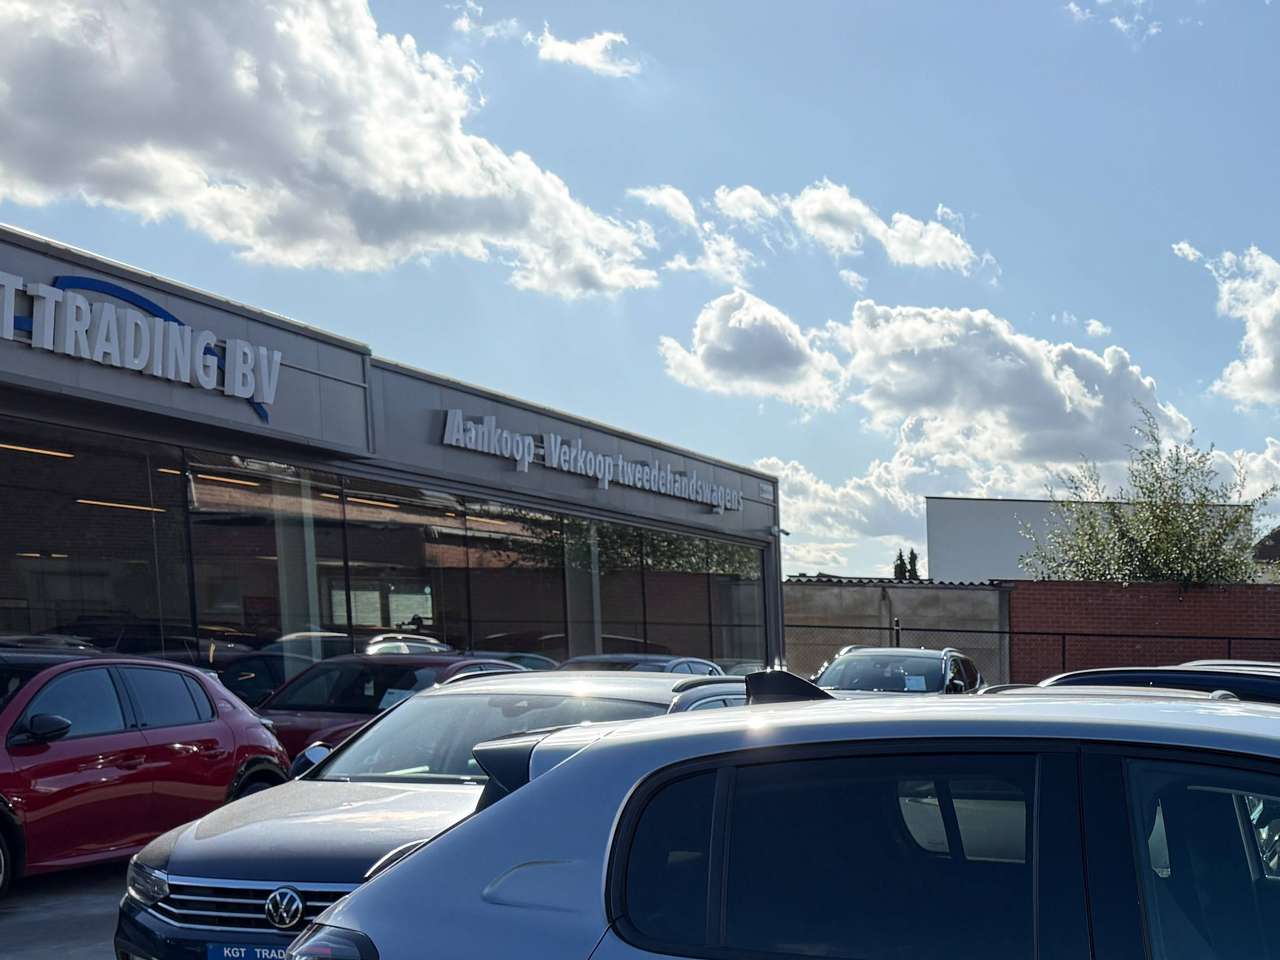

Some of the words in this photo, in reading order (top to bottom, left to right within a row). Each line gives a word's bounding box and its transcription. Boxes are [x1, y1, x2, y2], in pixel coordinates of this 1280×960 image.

[26, 281, 219, 391] TRADING
[224, 337, 282, 405] BV
[443, 409, 535, 473] Aankoop
[543, 432, 613, 490] Verkoop
[617, 453, 744, 515] tweedehandswagens
[223, 947, 247, 958] KGT
